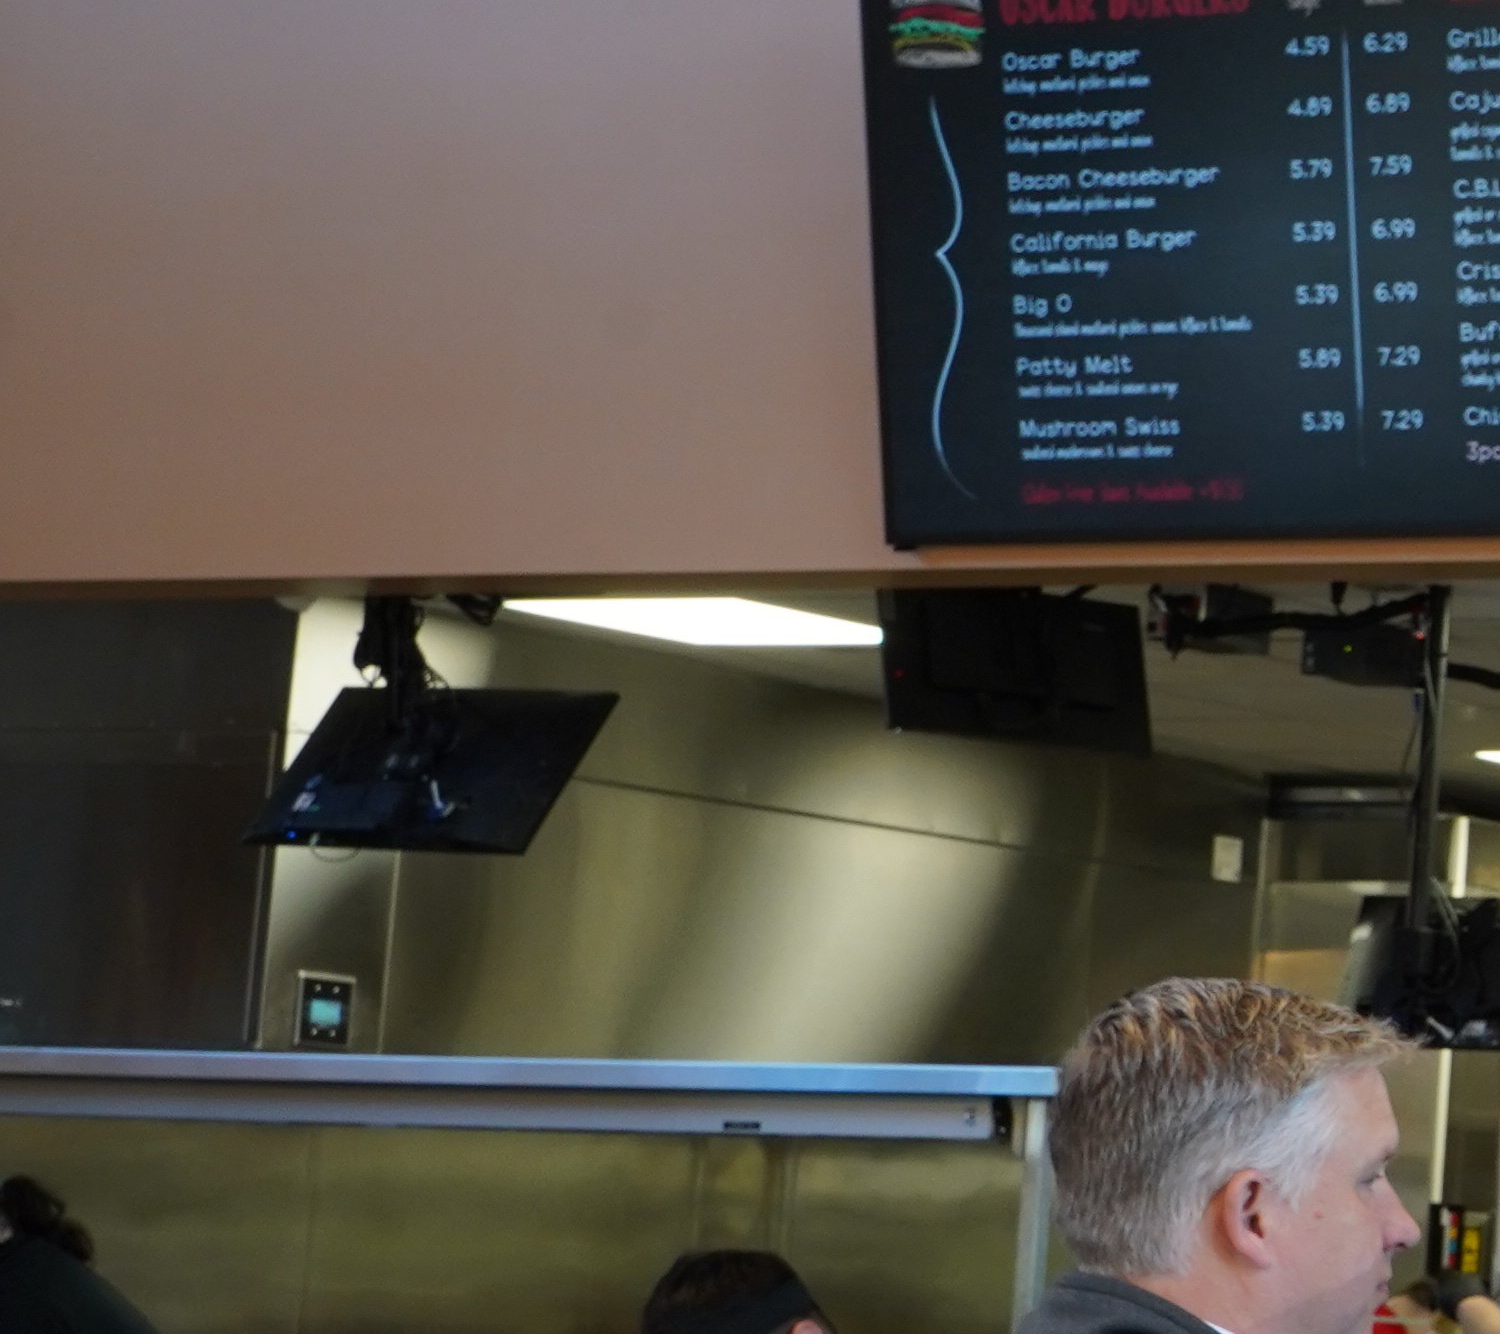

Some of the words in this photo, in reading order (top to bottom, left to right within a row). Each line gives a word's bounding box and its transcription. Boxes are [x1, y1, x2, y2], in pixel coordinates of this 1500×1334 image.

[1285, 36, 1330, 56] 4.59
[1002, 52, 1062, 71] Oscar
[1070, 49, 1140, 71] Burger
[1016, 357, 1077, 378] Patty
[1085, 355, 1133, 374] Melt
